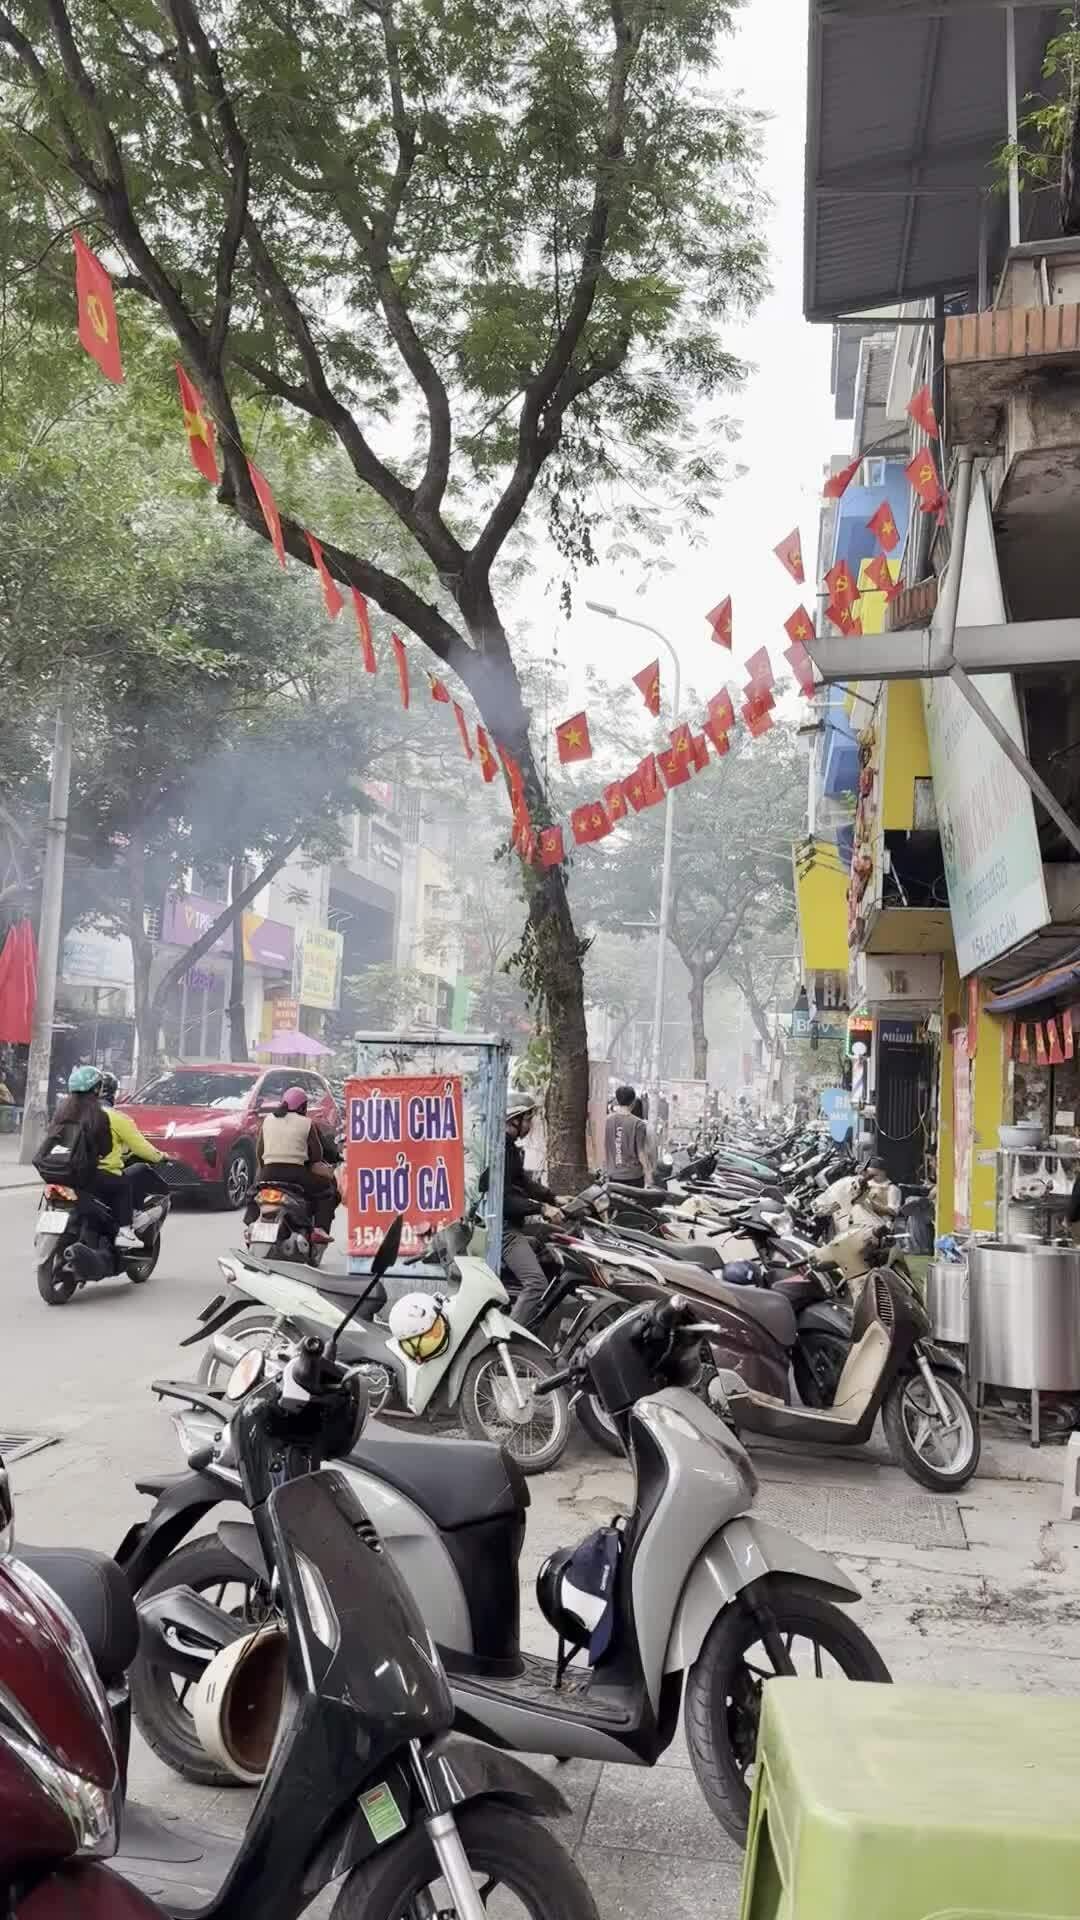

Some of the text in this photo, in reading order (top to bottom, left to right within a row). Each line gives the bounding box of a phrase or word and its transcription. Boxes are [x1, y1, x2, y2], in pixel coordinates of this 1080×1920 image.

[350, 1080, 458, 1142] BÚN CHẢ
[358, 1153, 453, 1212] PHỞ GÀ
